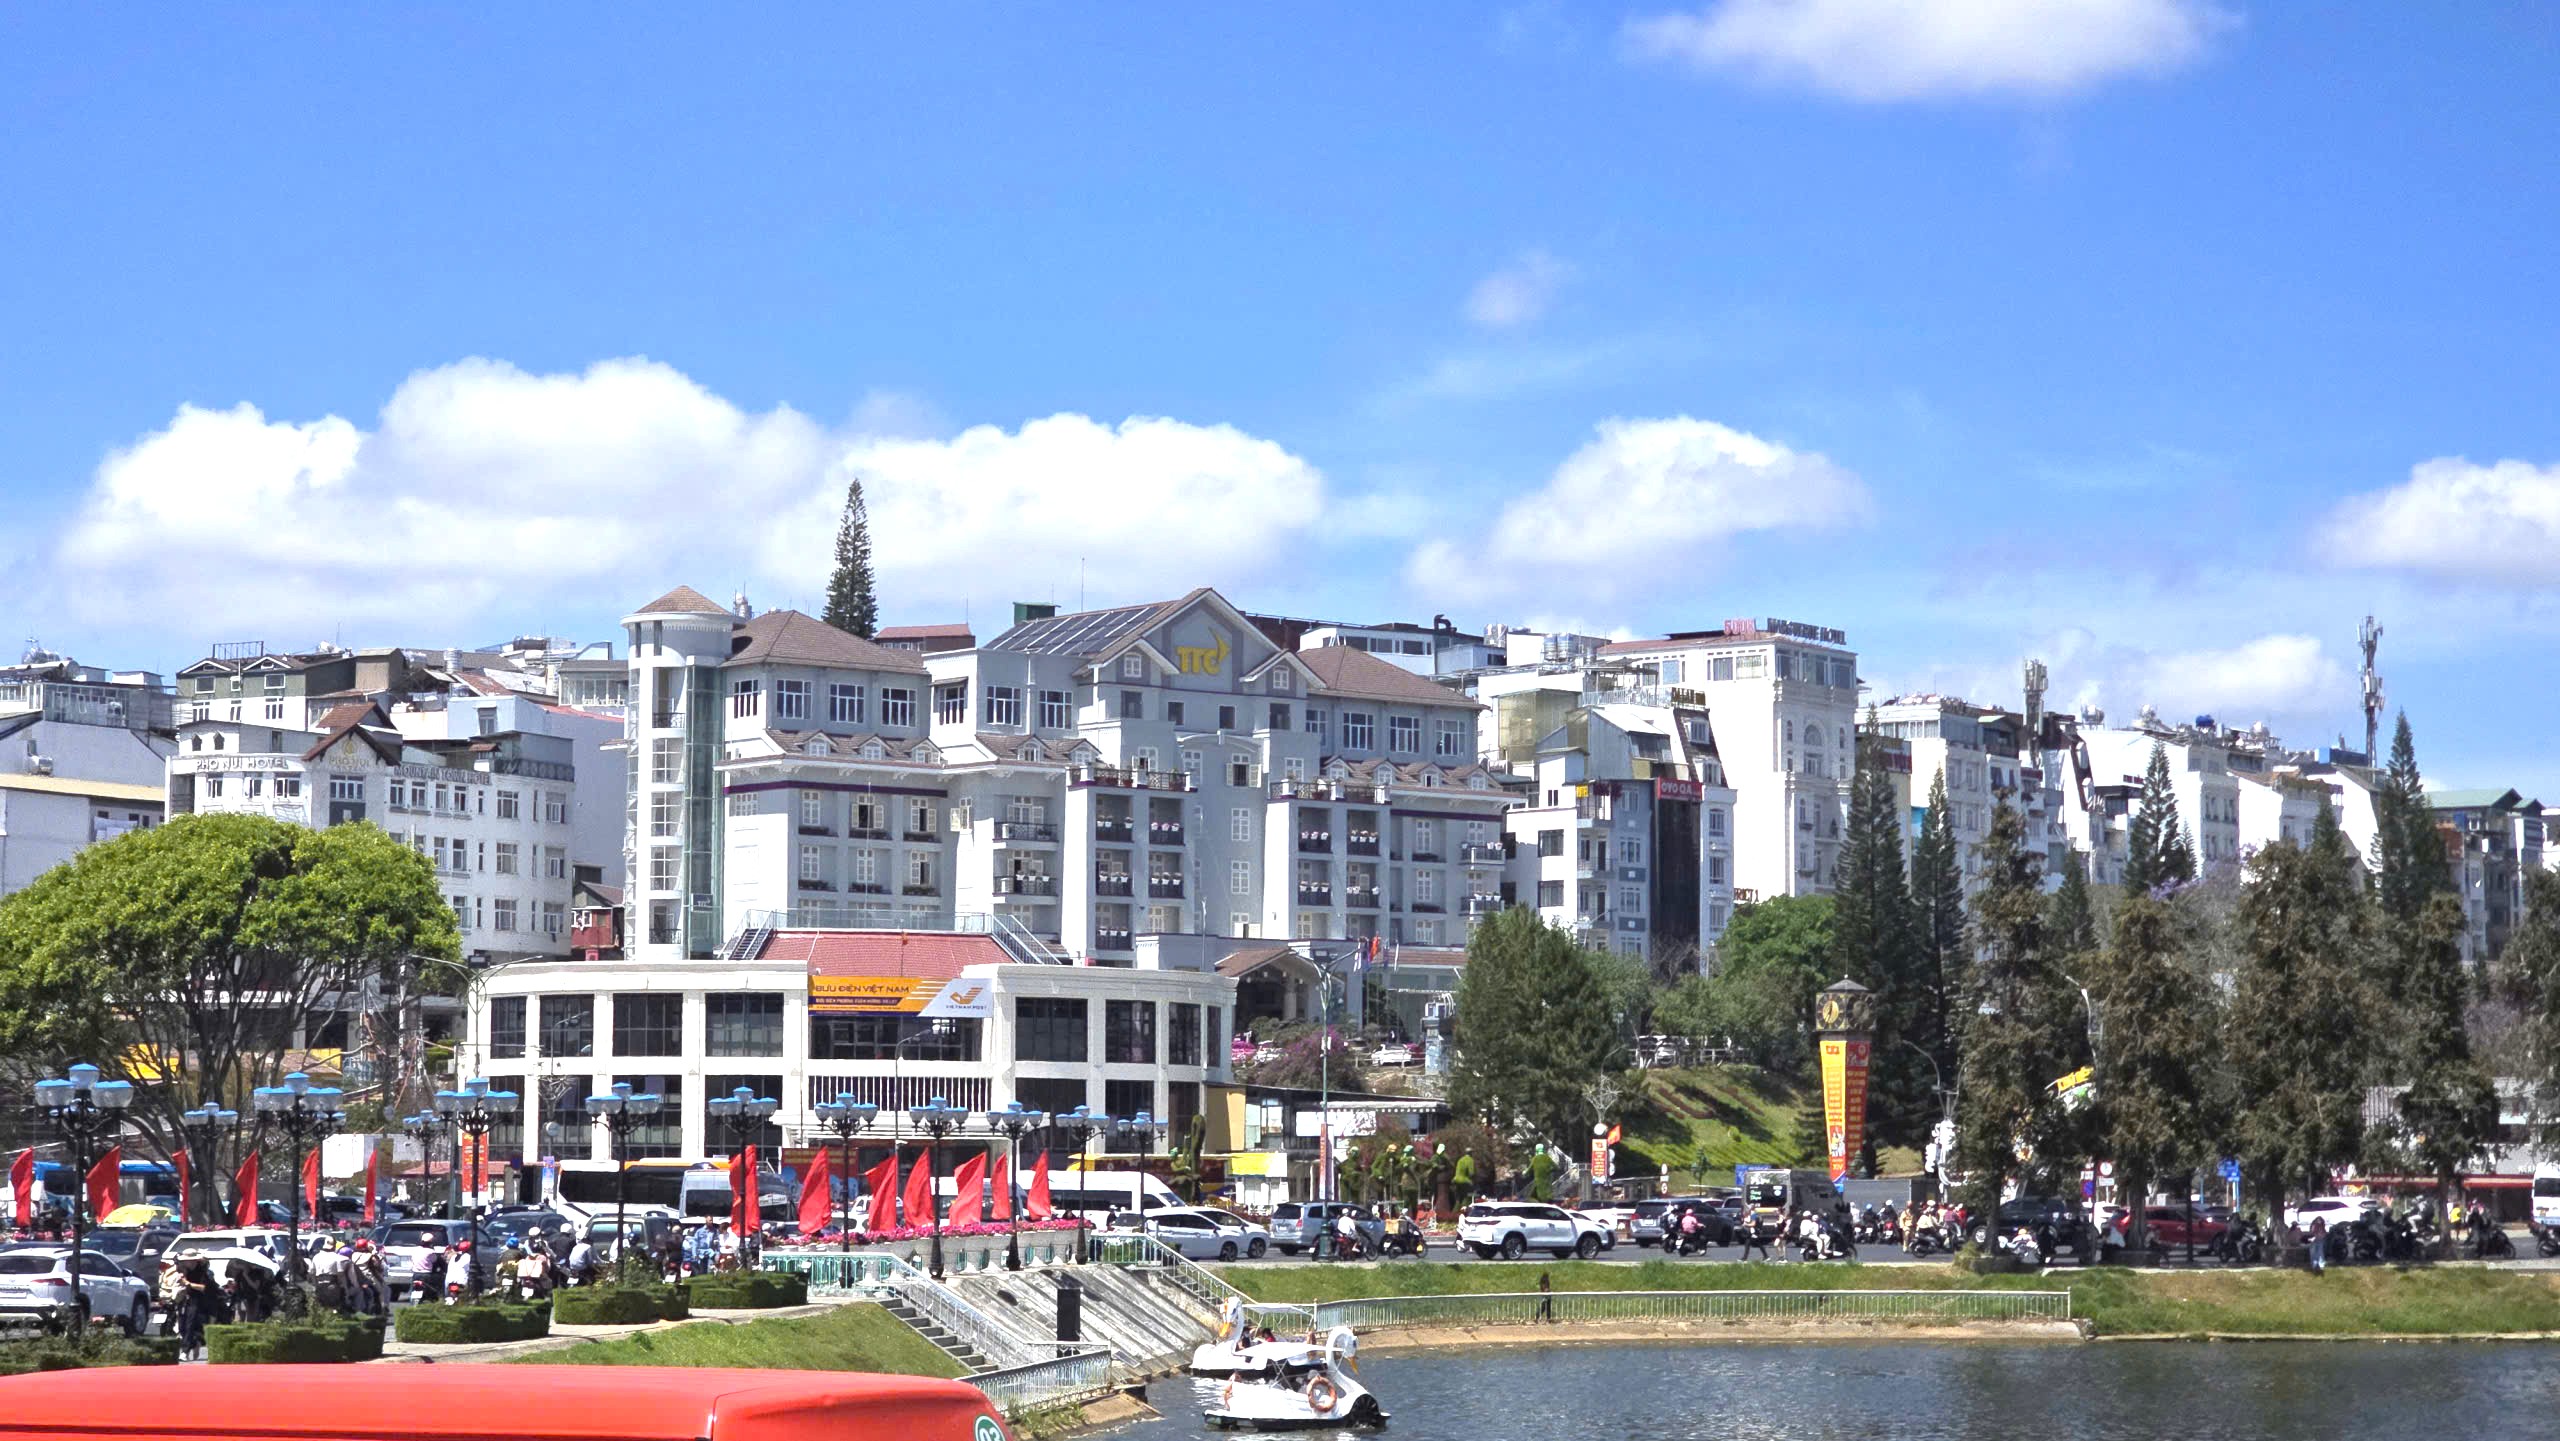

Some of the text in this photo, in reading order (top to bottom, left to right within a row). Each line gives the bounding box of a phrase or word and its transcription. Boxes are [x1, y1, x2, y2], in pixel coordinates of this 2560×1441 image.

[248, 757, 289, 769] HOTEL
[467, 771, 491, 785] HOTEL
[886, 985, 910, 993] NAM
